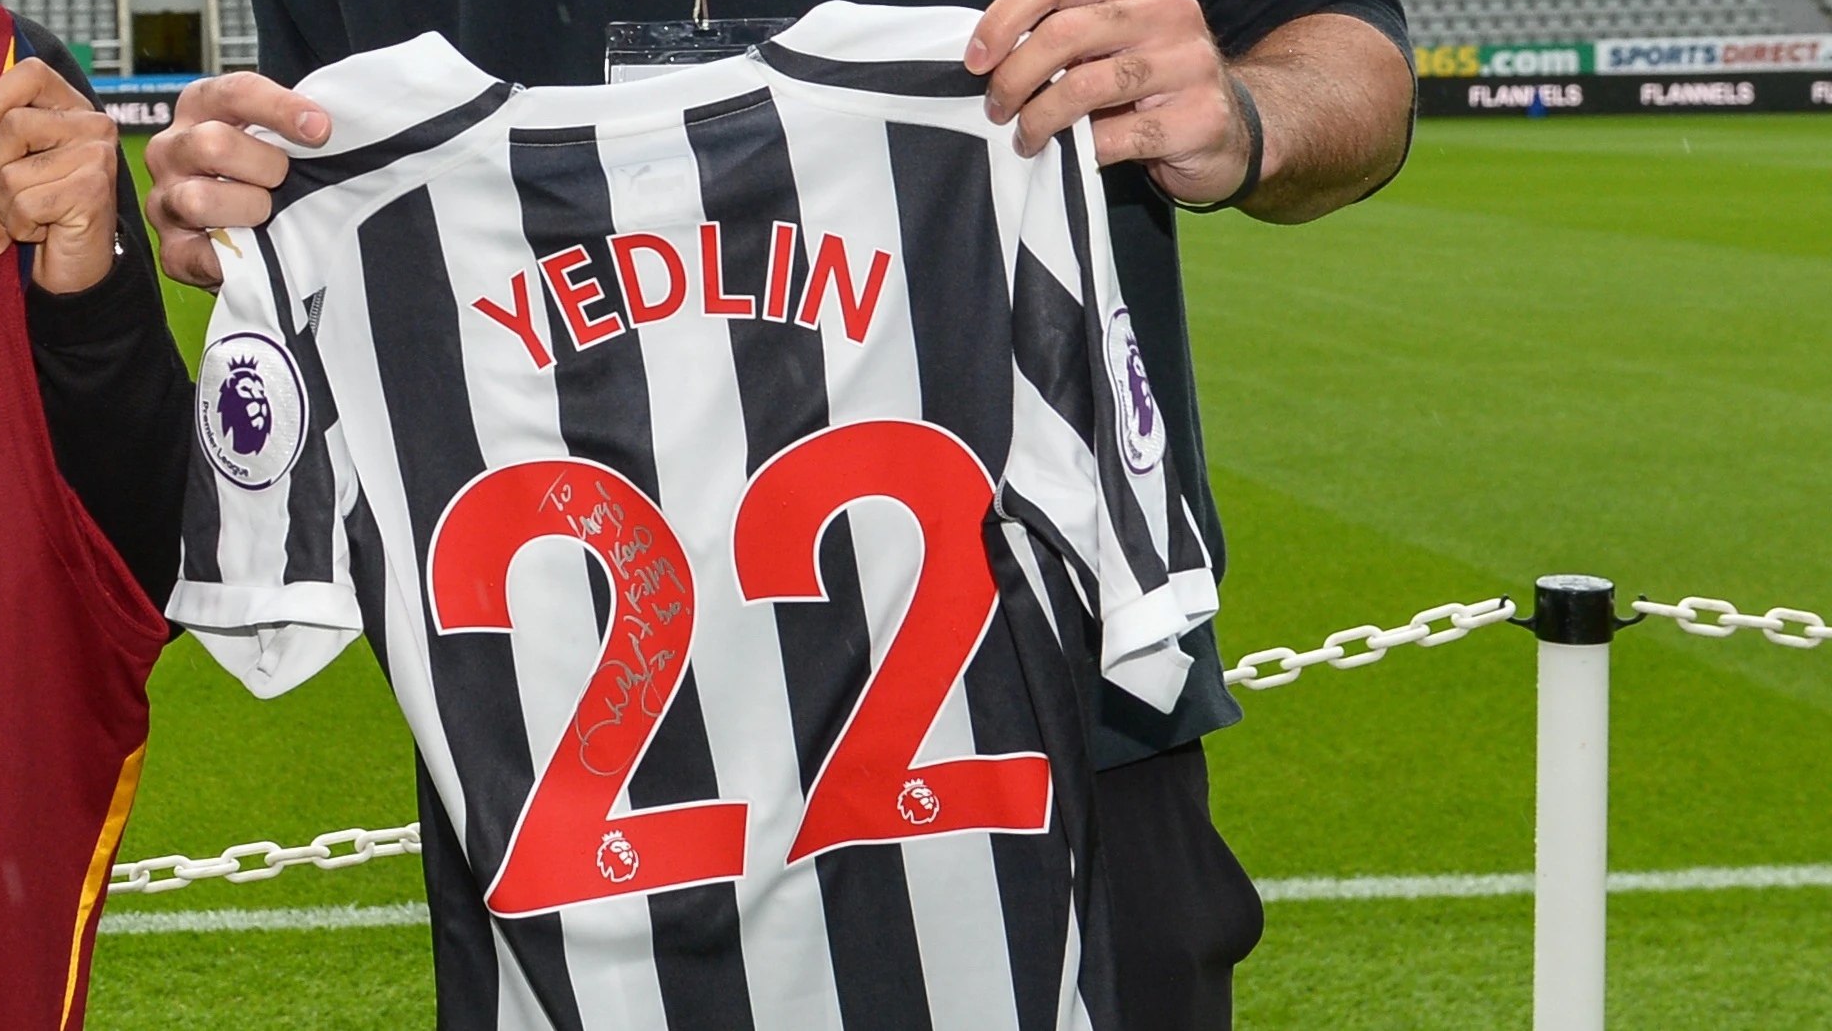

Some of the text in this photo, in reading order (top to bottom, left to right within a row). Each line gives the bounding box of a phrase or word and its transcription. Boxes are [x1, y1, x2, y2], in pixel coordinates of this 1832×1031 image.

[1609, 45, 1718, 67] SPORTS
[1640, 81, 1756, 106] FLANNELS
[471, 220, 893, 372] YEDLIN
[426, 418, 1055, 919] 22
